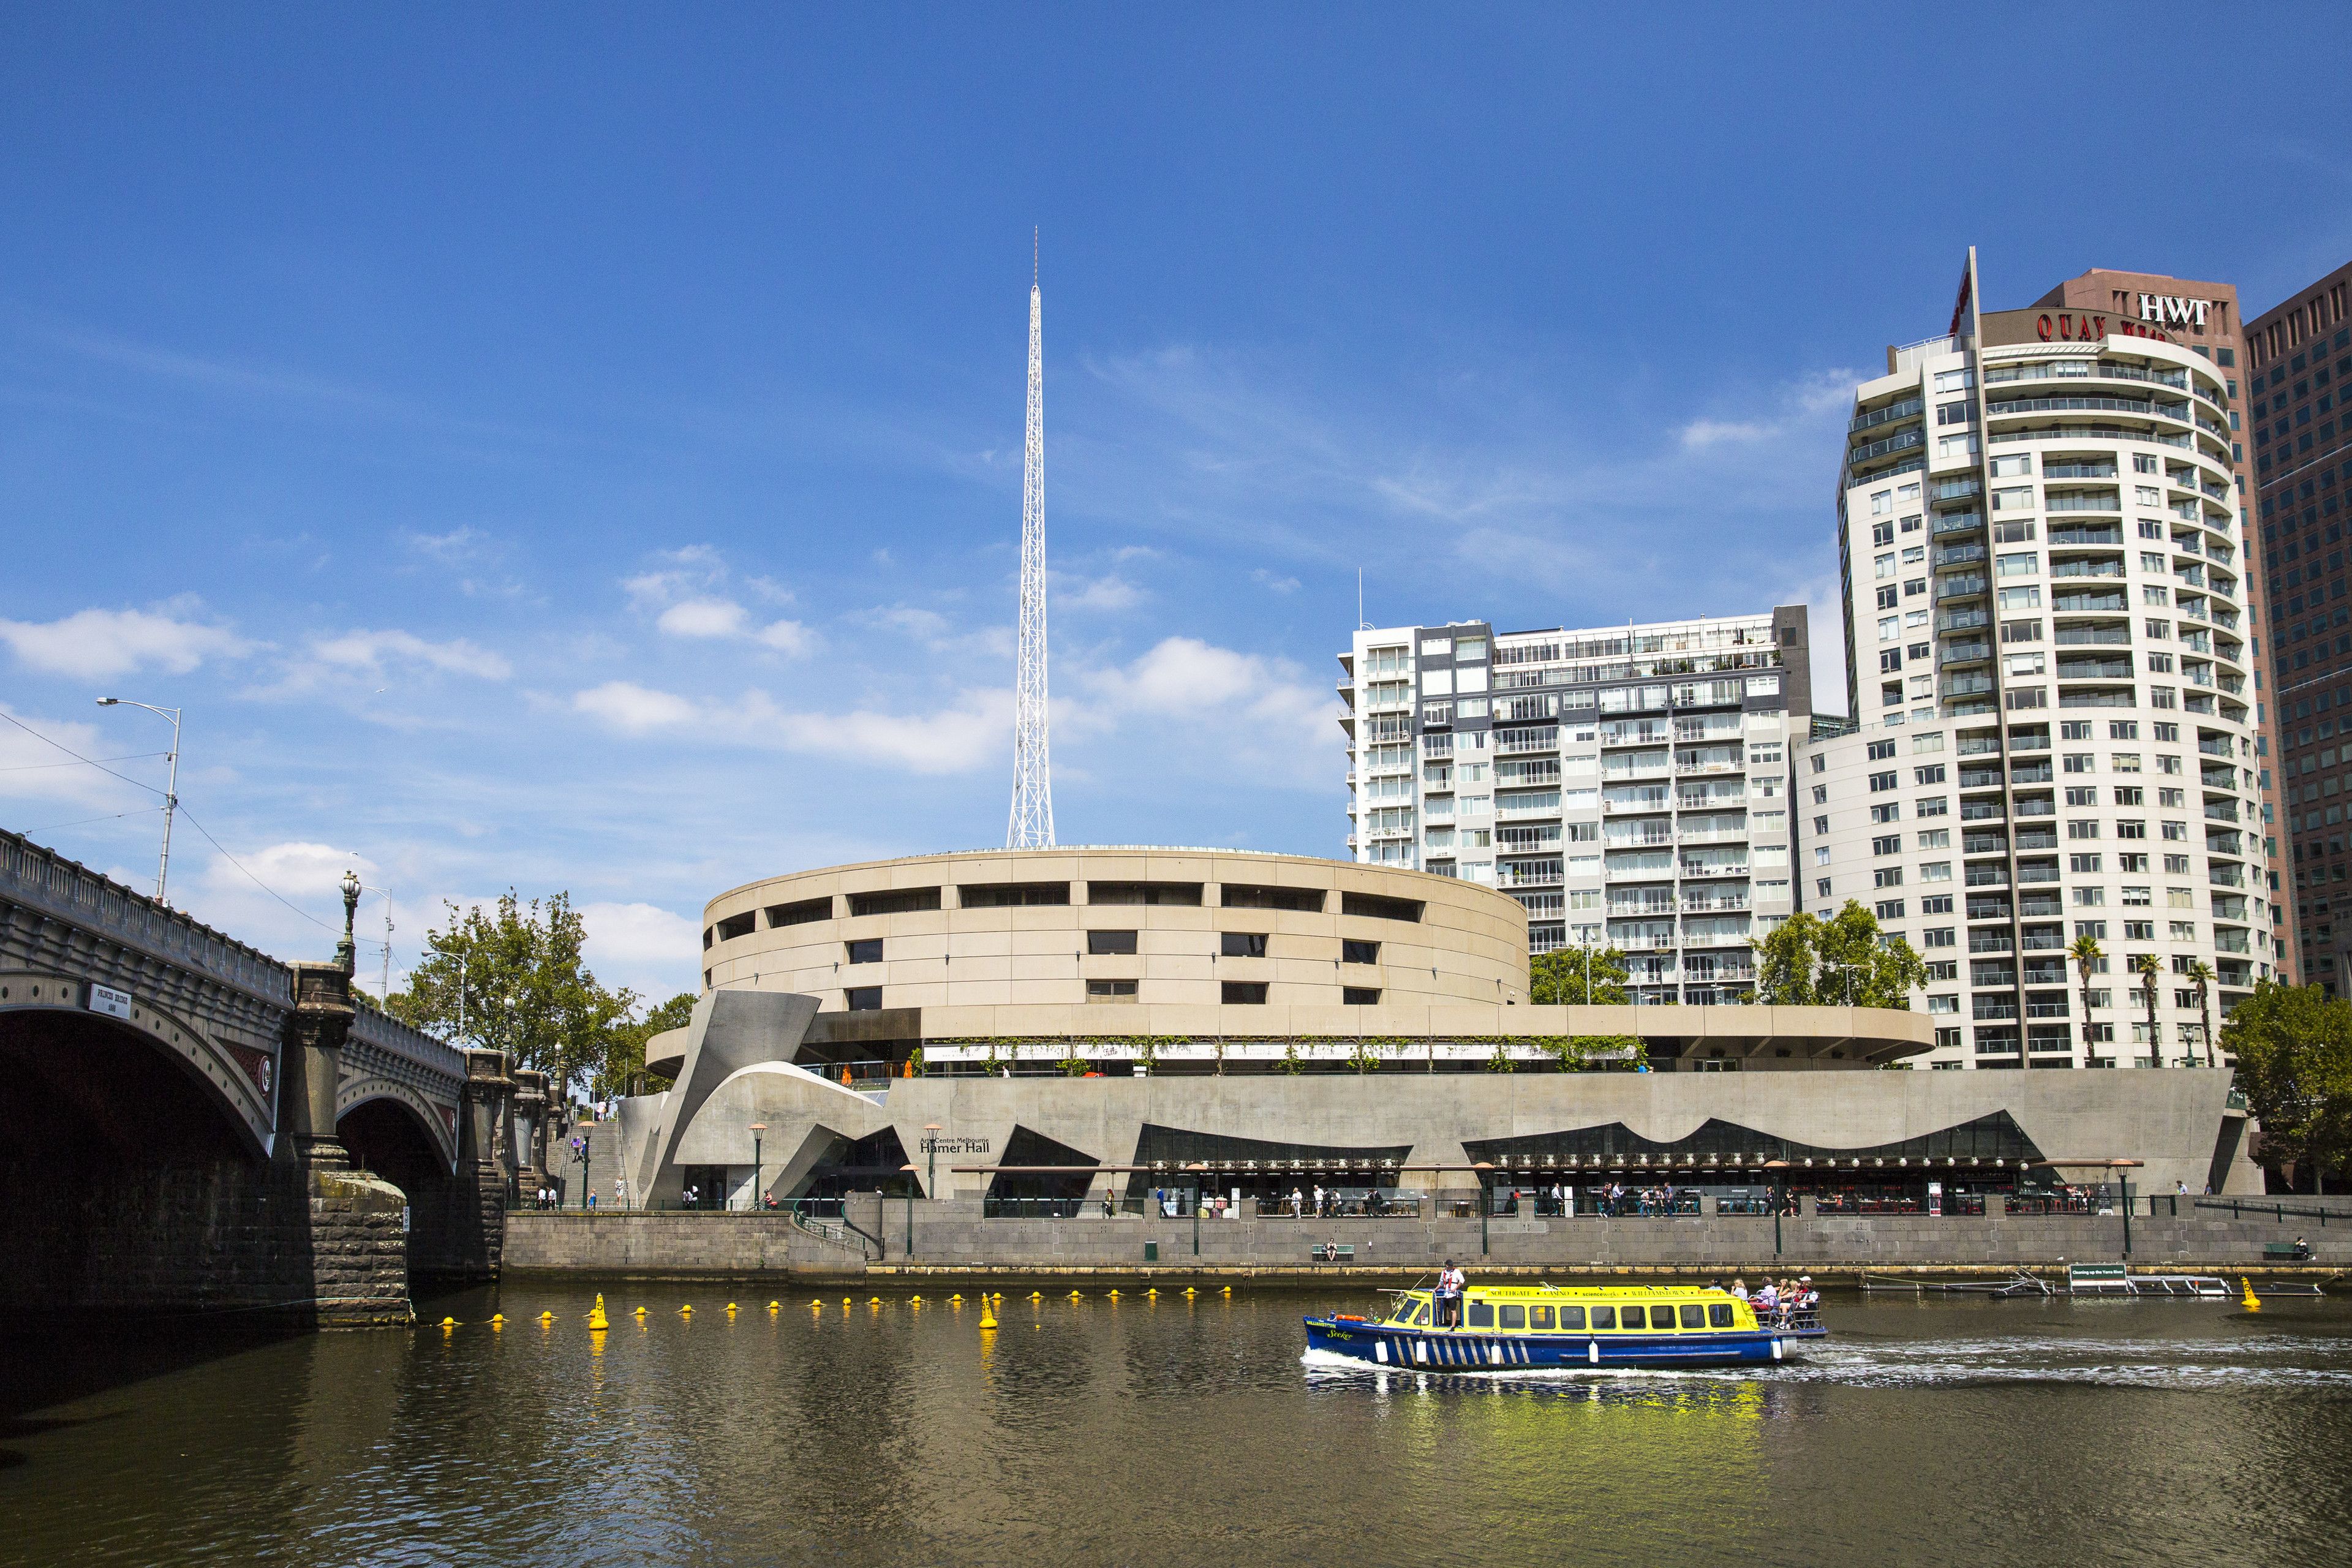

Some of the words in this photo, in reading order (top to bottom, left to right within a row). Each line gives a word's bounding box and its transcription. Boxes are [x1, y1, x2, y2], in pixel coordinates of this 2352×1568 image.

[2139, 293, 2211, 325] HWT
[2037, 314, 2106, 342] QUAY
[966, 1143, 989, 1153] Hall
[597, 1302, 603, 1311] 5
[1326, 1330, 1353, 1341] Seeker
